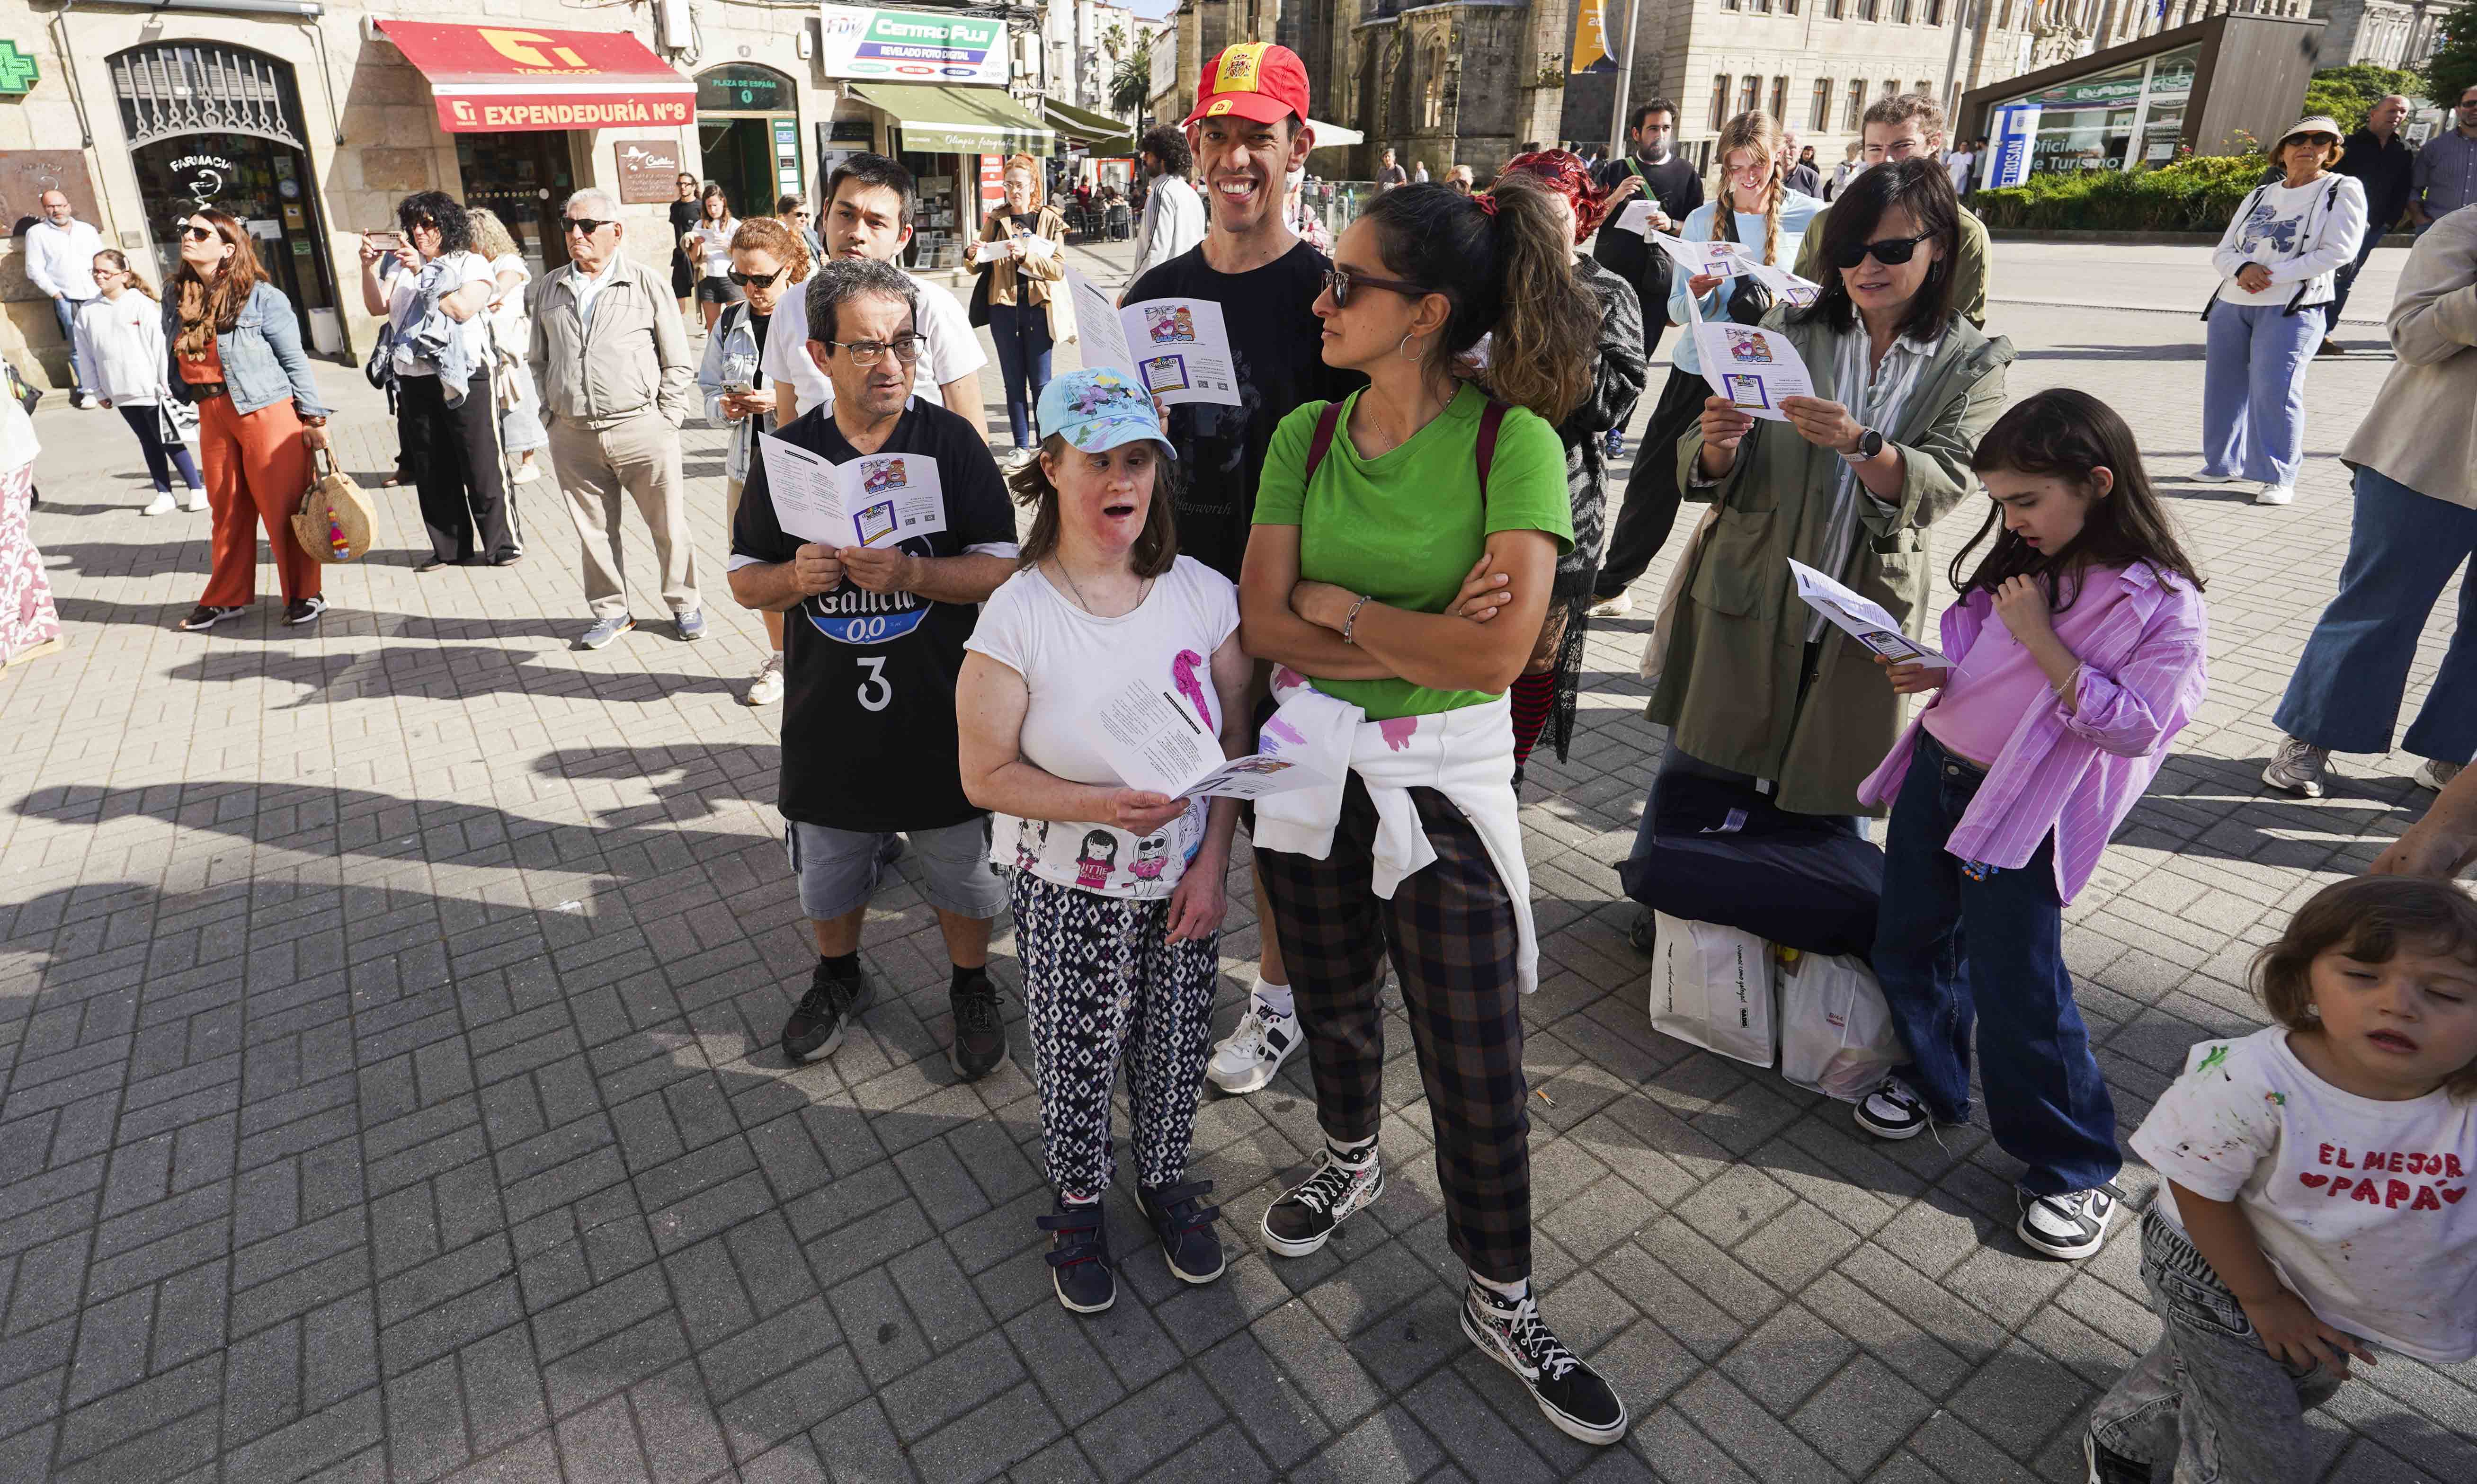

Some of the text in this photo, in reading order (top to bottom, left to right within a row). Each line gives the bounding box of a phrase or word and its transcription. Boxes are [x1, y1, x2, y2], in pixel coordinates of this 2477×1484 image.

[881, 46, 970, 60] REVELADO FOTO DIGITAL
[749, 80, 777, 89] ESPAÑA
[484, 98, 650, 125] EXPENDEDURÍA
[169, 155, 232, 172] FARMACIA
[2049, 156, 2119, 169] Turismo
[1175, 499, 1231, 515] Hayworth
[856, 656, 892, 711] 3
[1079, 871, 1106, 880] DRESS
[1080, 863, 1108, 875] LITTLE
[1740, 1008, 1748, 1027] GADIS
[2319, 1143, 2464, 1178] EL MEJOR
[2327, 1176, 2448, 1210] PAPÁ
